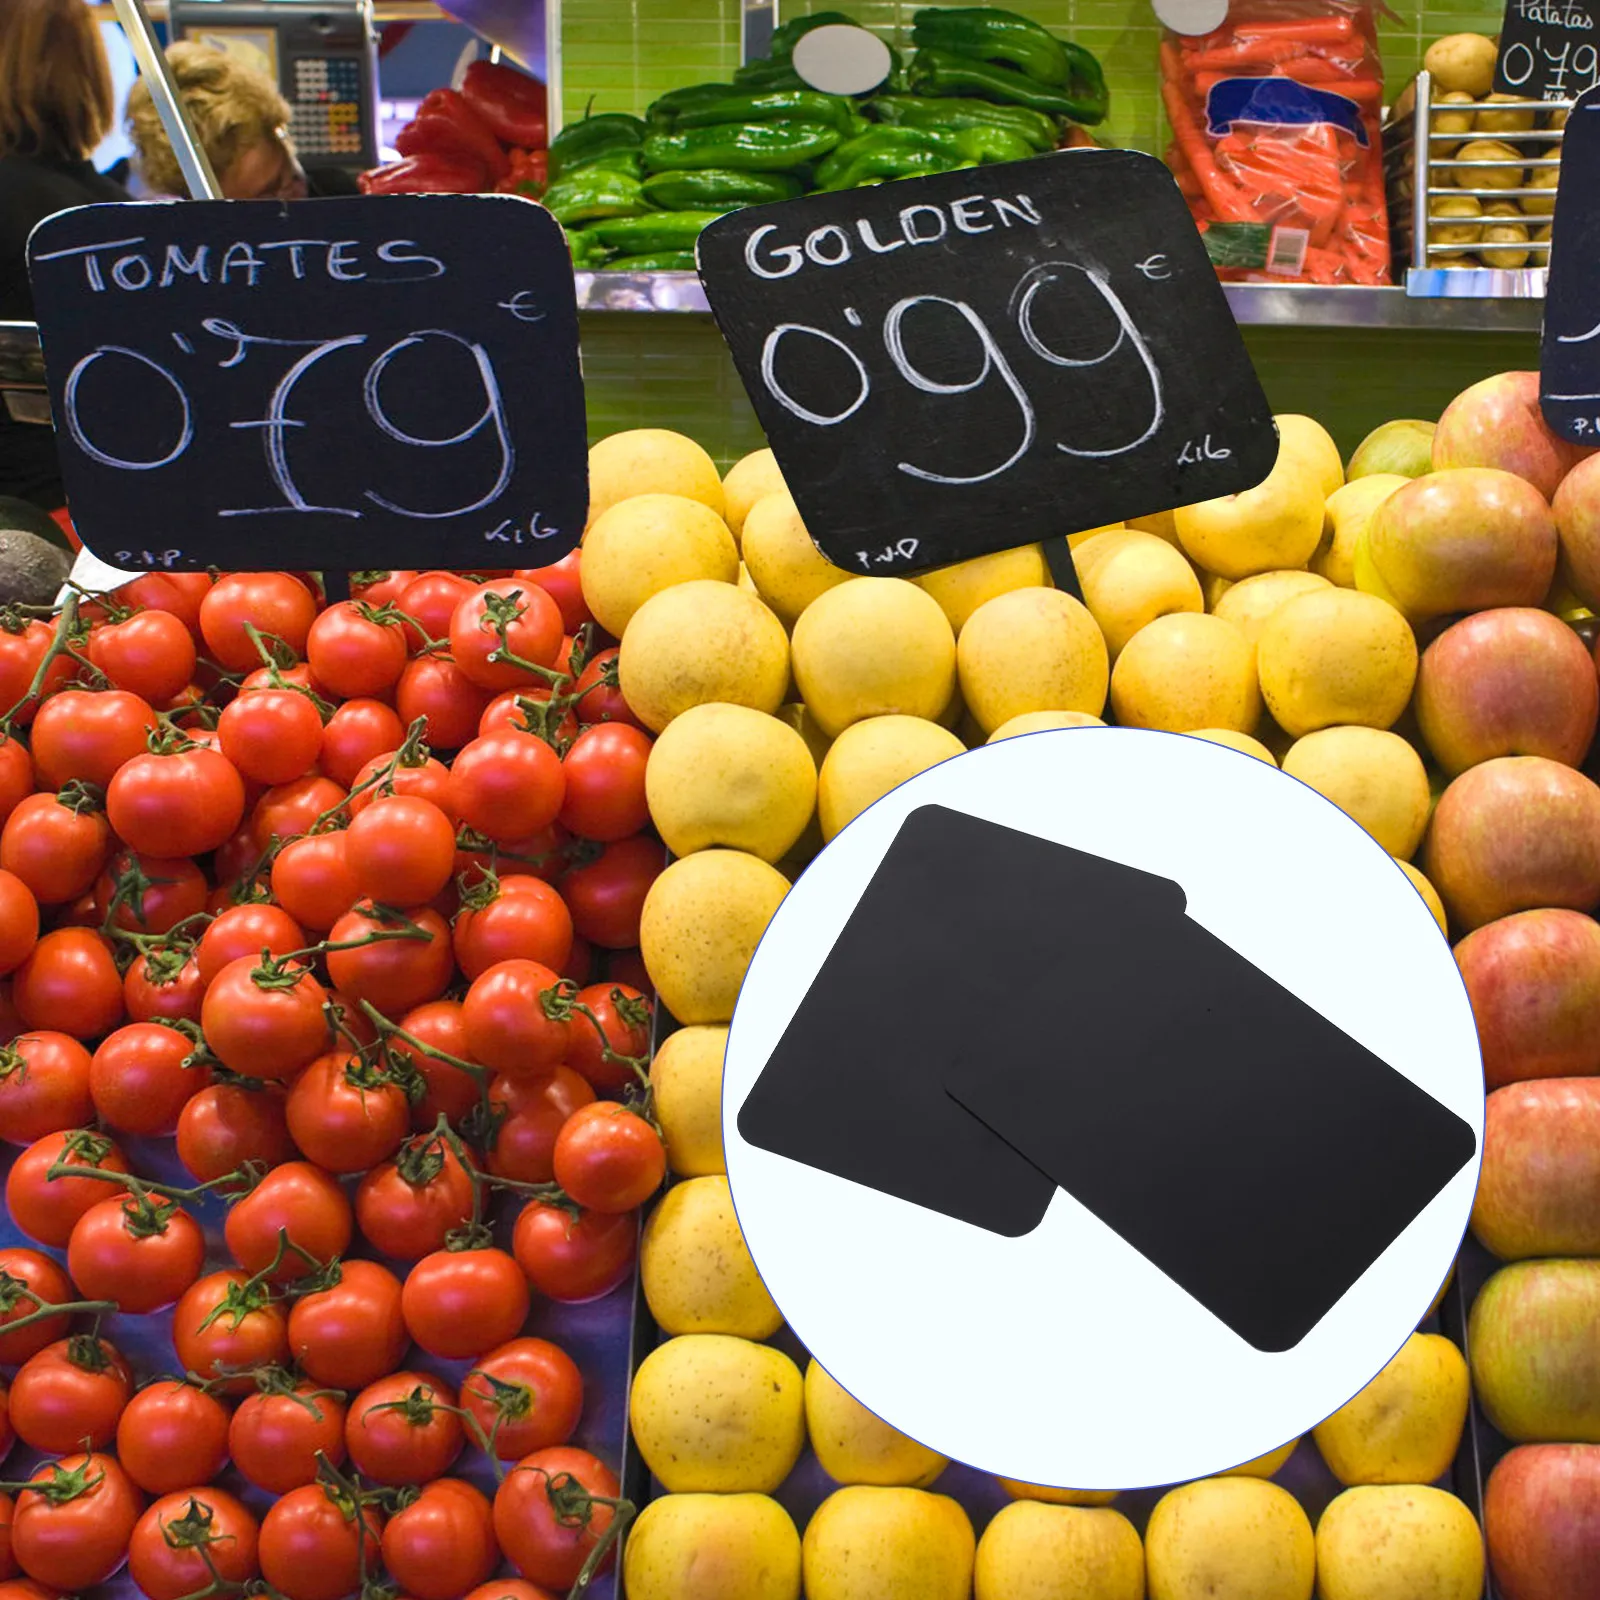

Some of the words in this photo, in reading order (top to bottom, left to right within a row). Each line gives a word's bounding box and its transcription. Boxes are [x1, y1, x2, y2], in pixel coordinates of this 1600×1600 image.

[35, 237, 446, 292] TOMATES
[744, 194, 1042, 280] GOLDEN
[1135, 253, 1172, 281] €
[498, 290, 547, 321] €
[760, 259, 1165, 485] 0'99
